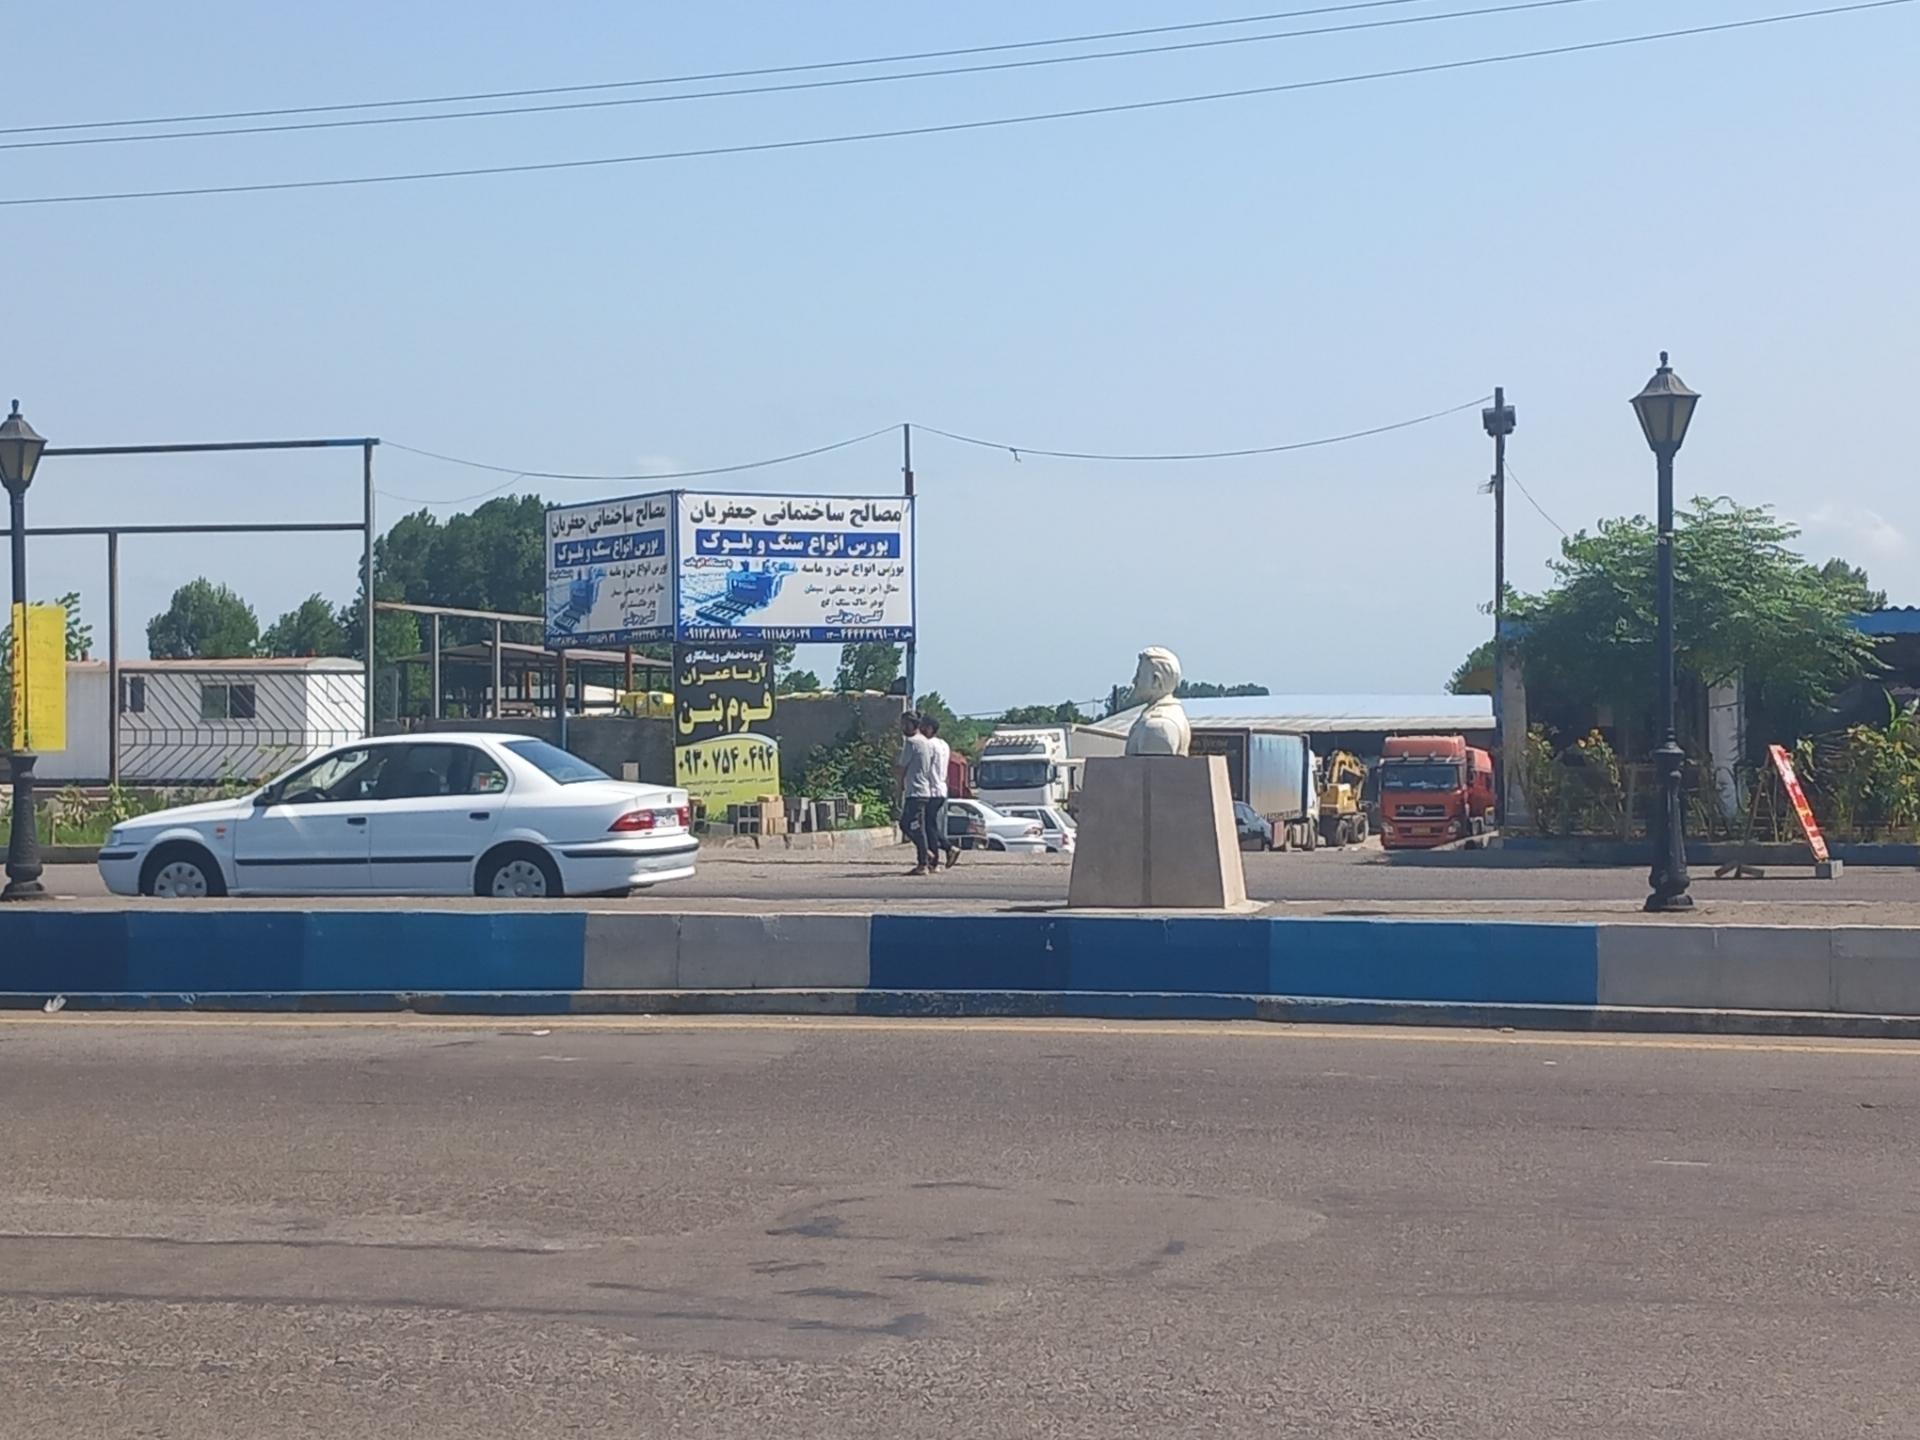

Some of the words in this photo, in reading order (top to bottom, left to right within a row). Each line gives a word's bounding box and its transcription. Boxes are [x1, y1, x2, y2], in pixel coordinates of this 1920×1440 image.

[588, 504, 634, 533] ساختمانی
[636, 501, 665, 527] مصالح
[690, 500, 757, 525] جعفریان
[763, 500, 844, 526] ساختمانی
[850, 502, 901, 527] مصالح
[612, 536, 633, 560] انواع
[703, 532, 752, 554] بلوک
[757, 540, 765, 555] و
[769, 533, 804, 550] سنگ
[808, 534, 844, 556] انواع
[848, 539, 889, 556] بورس
[851, 563, 876, 577] انواع
[680, 666, 731, 685] عمران
[732, 662, 767, 683] آریا
[679, 693, 724, 734] بتن
[726, 682, 773, 733] فوم
